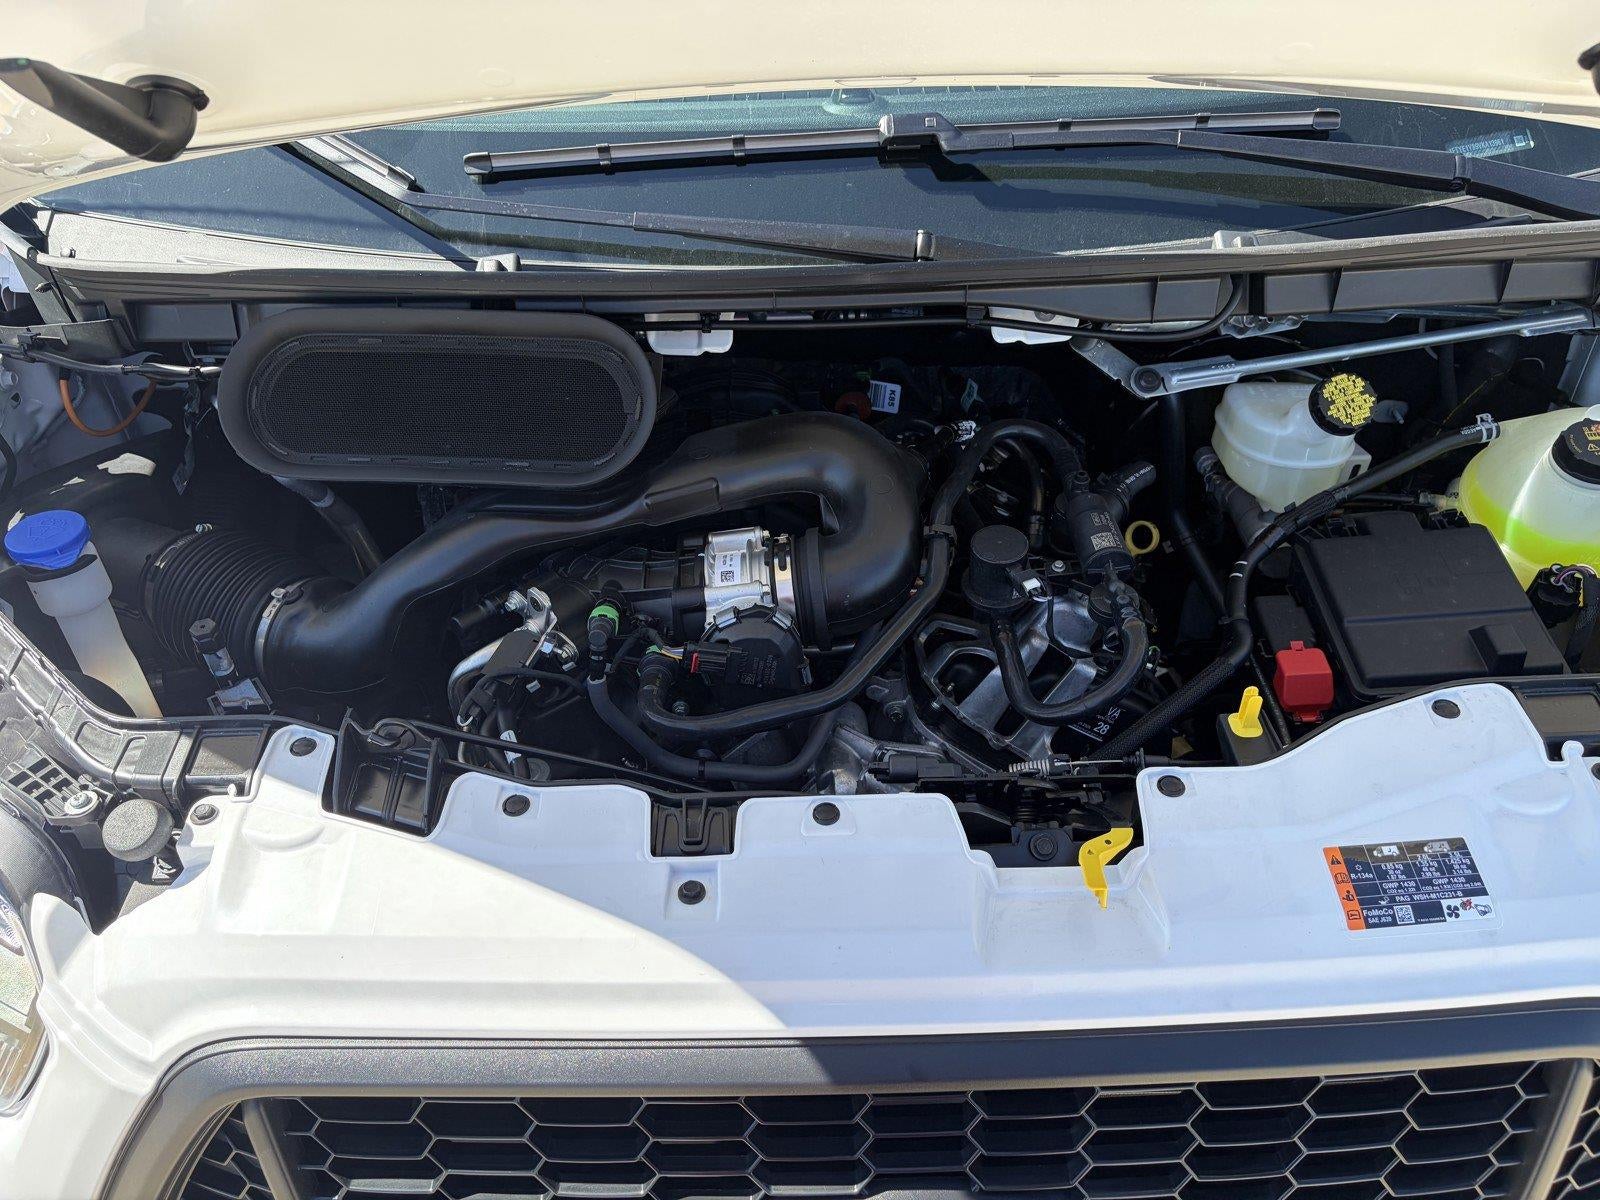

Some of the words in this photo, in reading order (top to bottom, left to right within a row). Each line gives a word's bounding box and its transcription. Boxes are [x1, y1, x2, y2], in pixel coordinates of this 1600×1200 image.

[888, 389, 896, 408] K85
[1093, 721, 1110, 735] 28
[1363, 908, 1393, 916] FoMoCo
